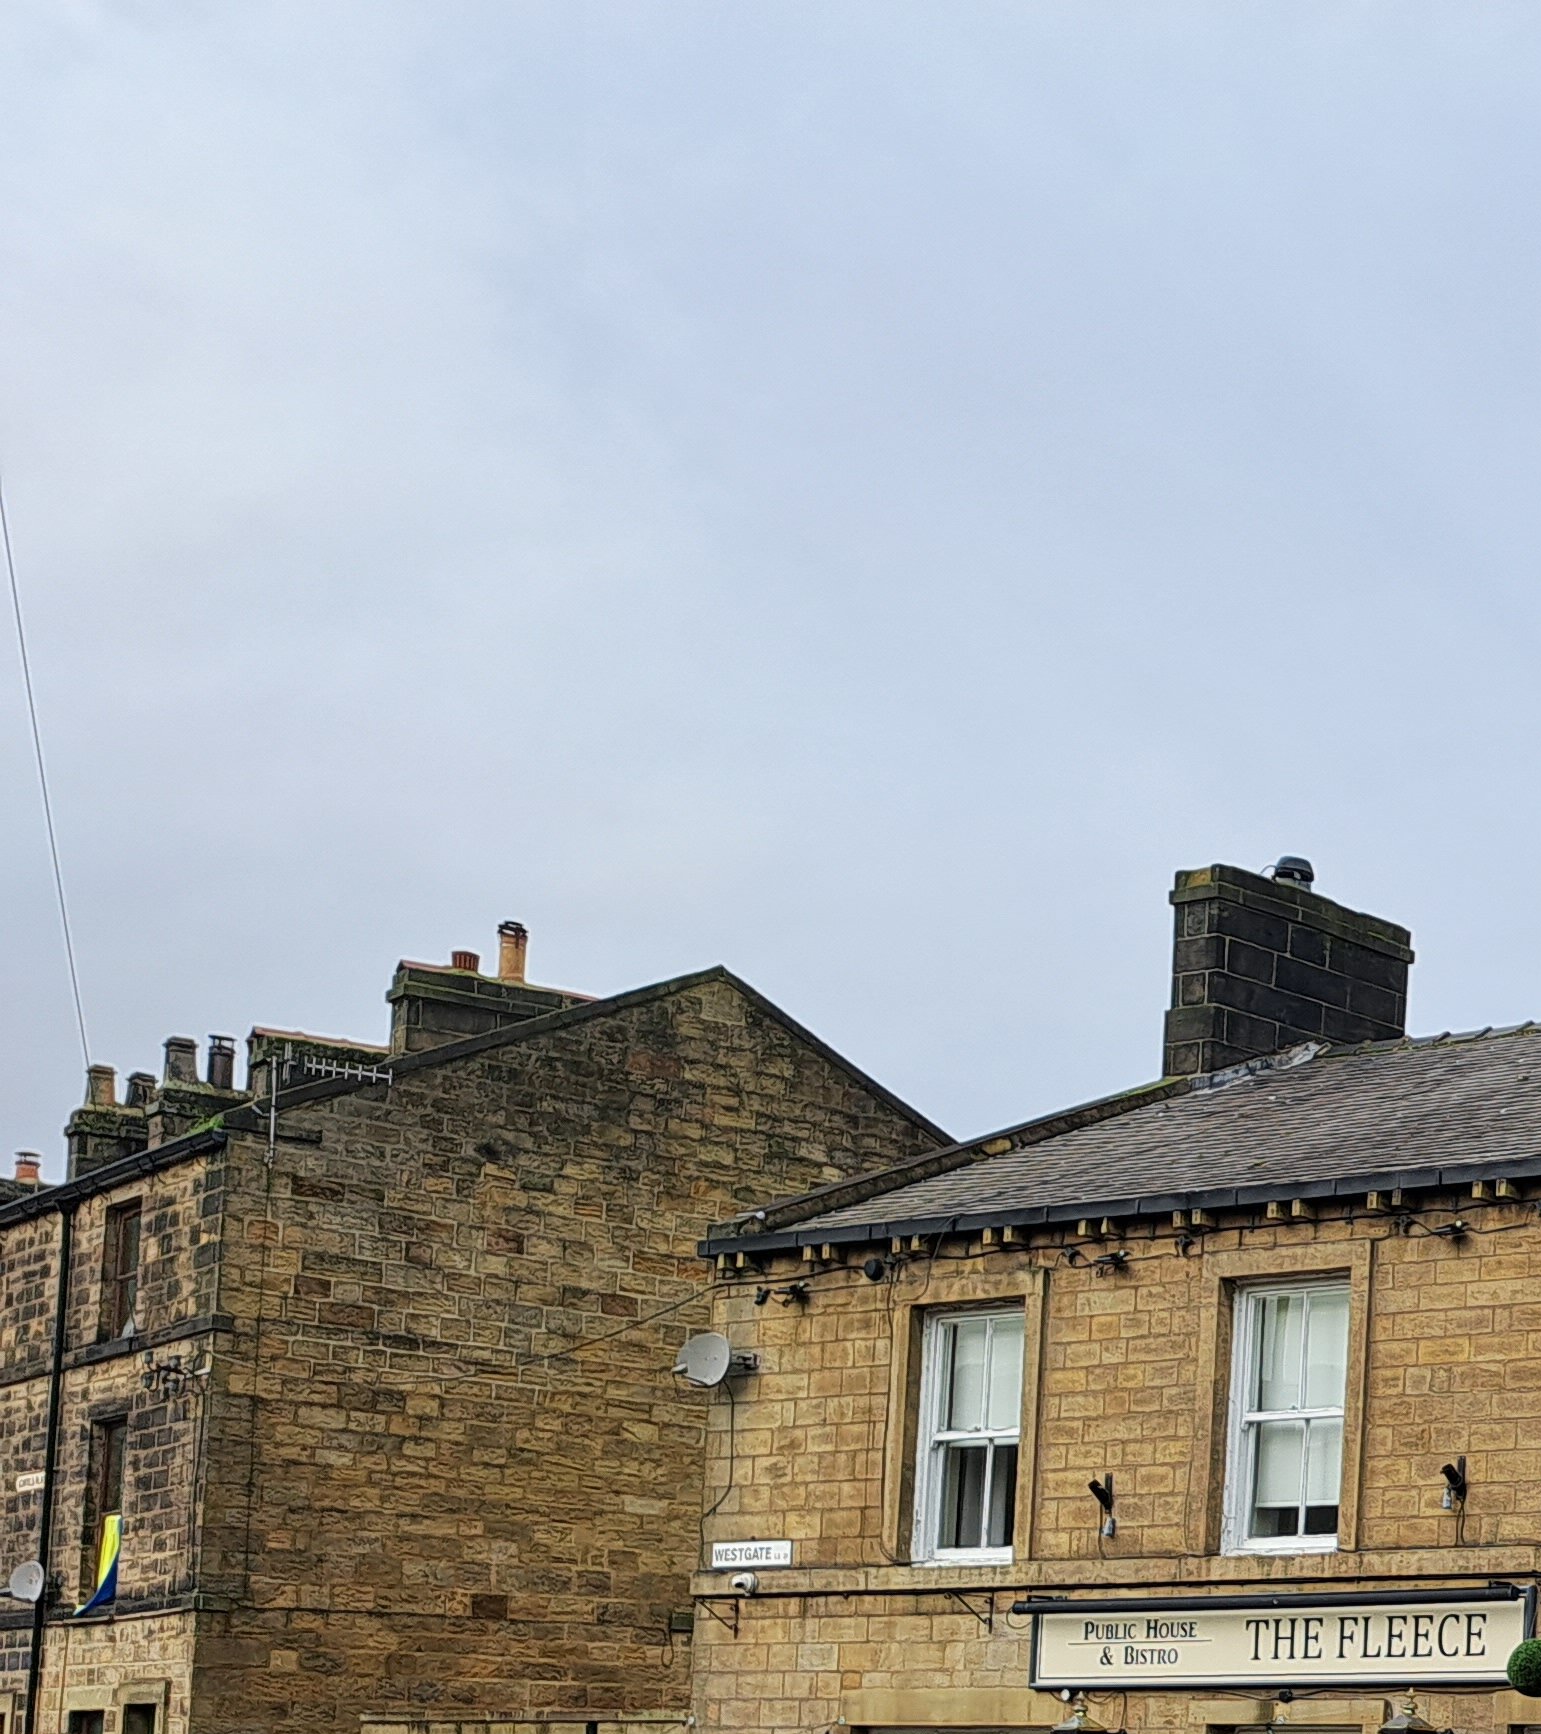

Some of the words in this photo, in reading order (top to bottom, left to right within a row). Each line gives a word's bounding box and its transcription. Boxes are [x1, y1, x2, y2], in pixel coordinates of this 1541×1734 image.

[714, 1546, 772, 1562] WESTGATE
[1245, 1617, 1324, 1661] THE
[1336, 1613, 1487, 1658] FLEECE
[1100, 1646, 1114, 1666] &
